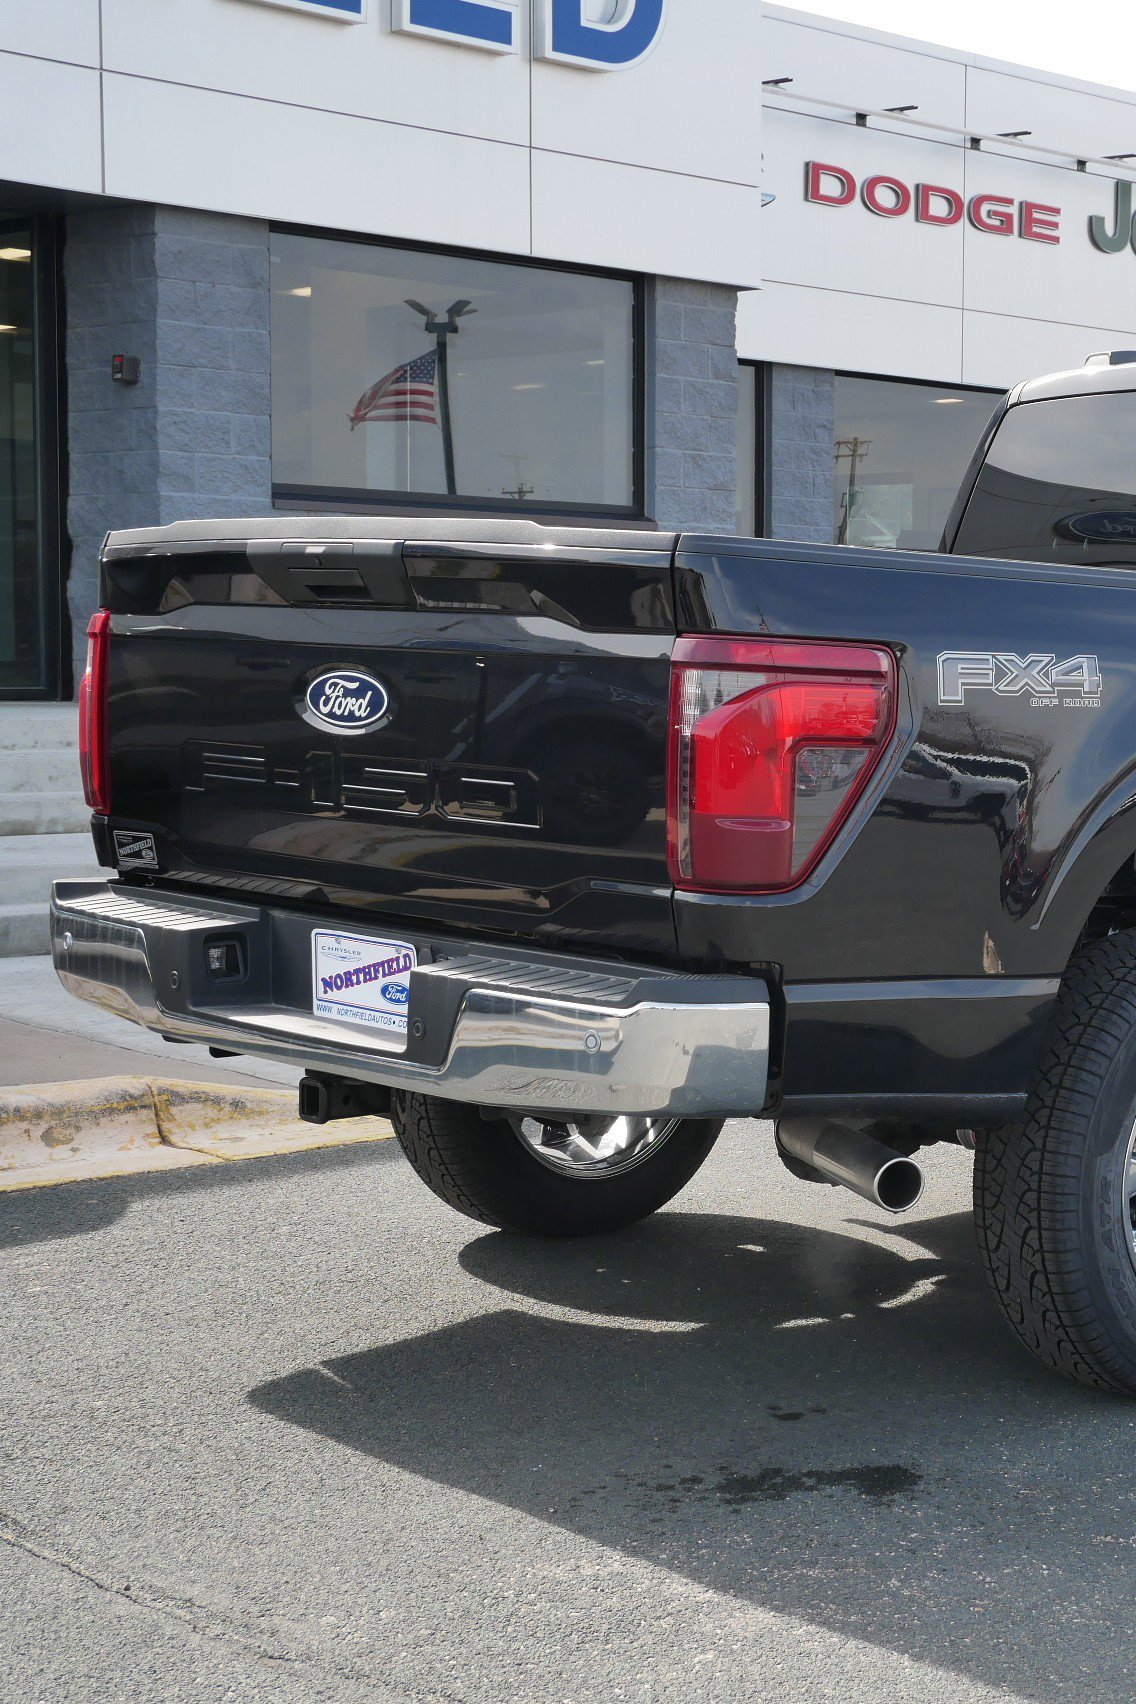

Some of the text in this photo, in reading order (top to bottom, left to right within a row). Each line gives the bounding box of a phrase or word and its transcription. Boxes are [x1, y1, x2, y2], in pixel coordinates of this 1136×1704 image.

[803, 160, 1062, 245] DODGE
[319, 678, 373, 718] Ford
[937, 651, 1102, 706] FX4
[1030, 698, 1101, 707] OFF ROAD
[321, 945, 362, 956] CHRYSLER
[321, 953, 412, 995] NORTHFIELD
[385, 983, 407, 1001] Ford
